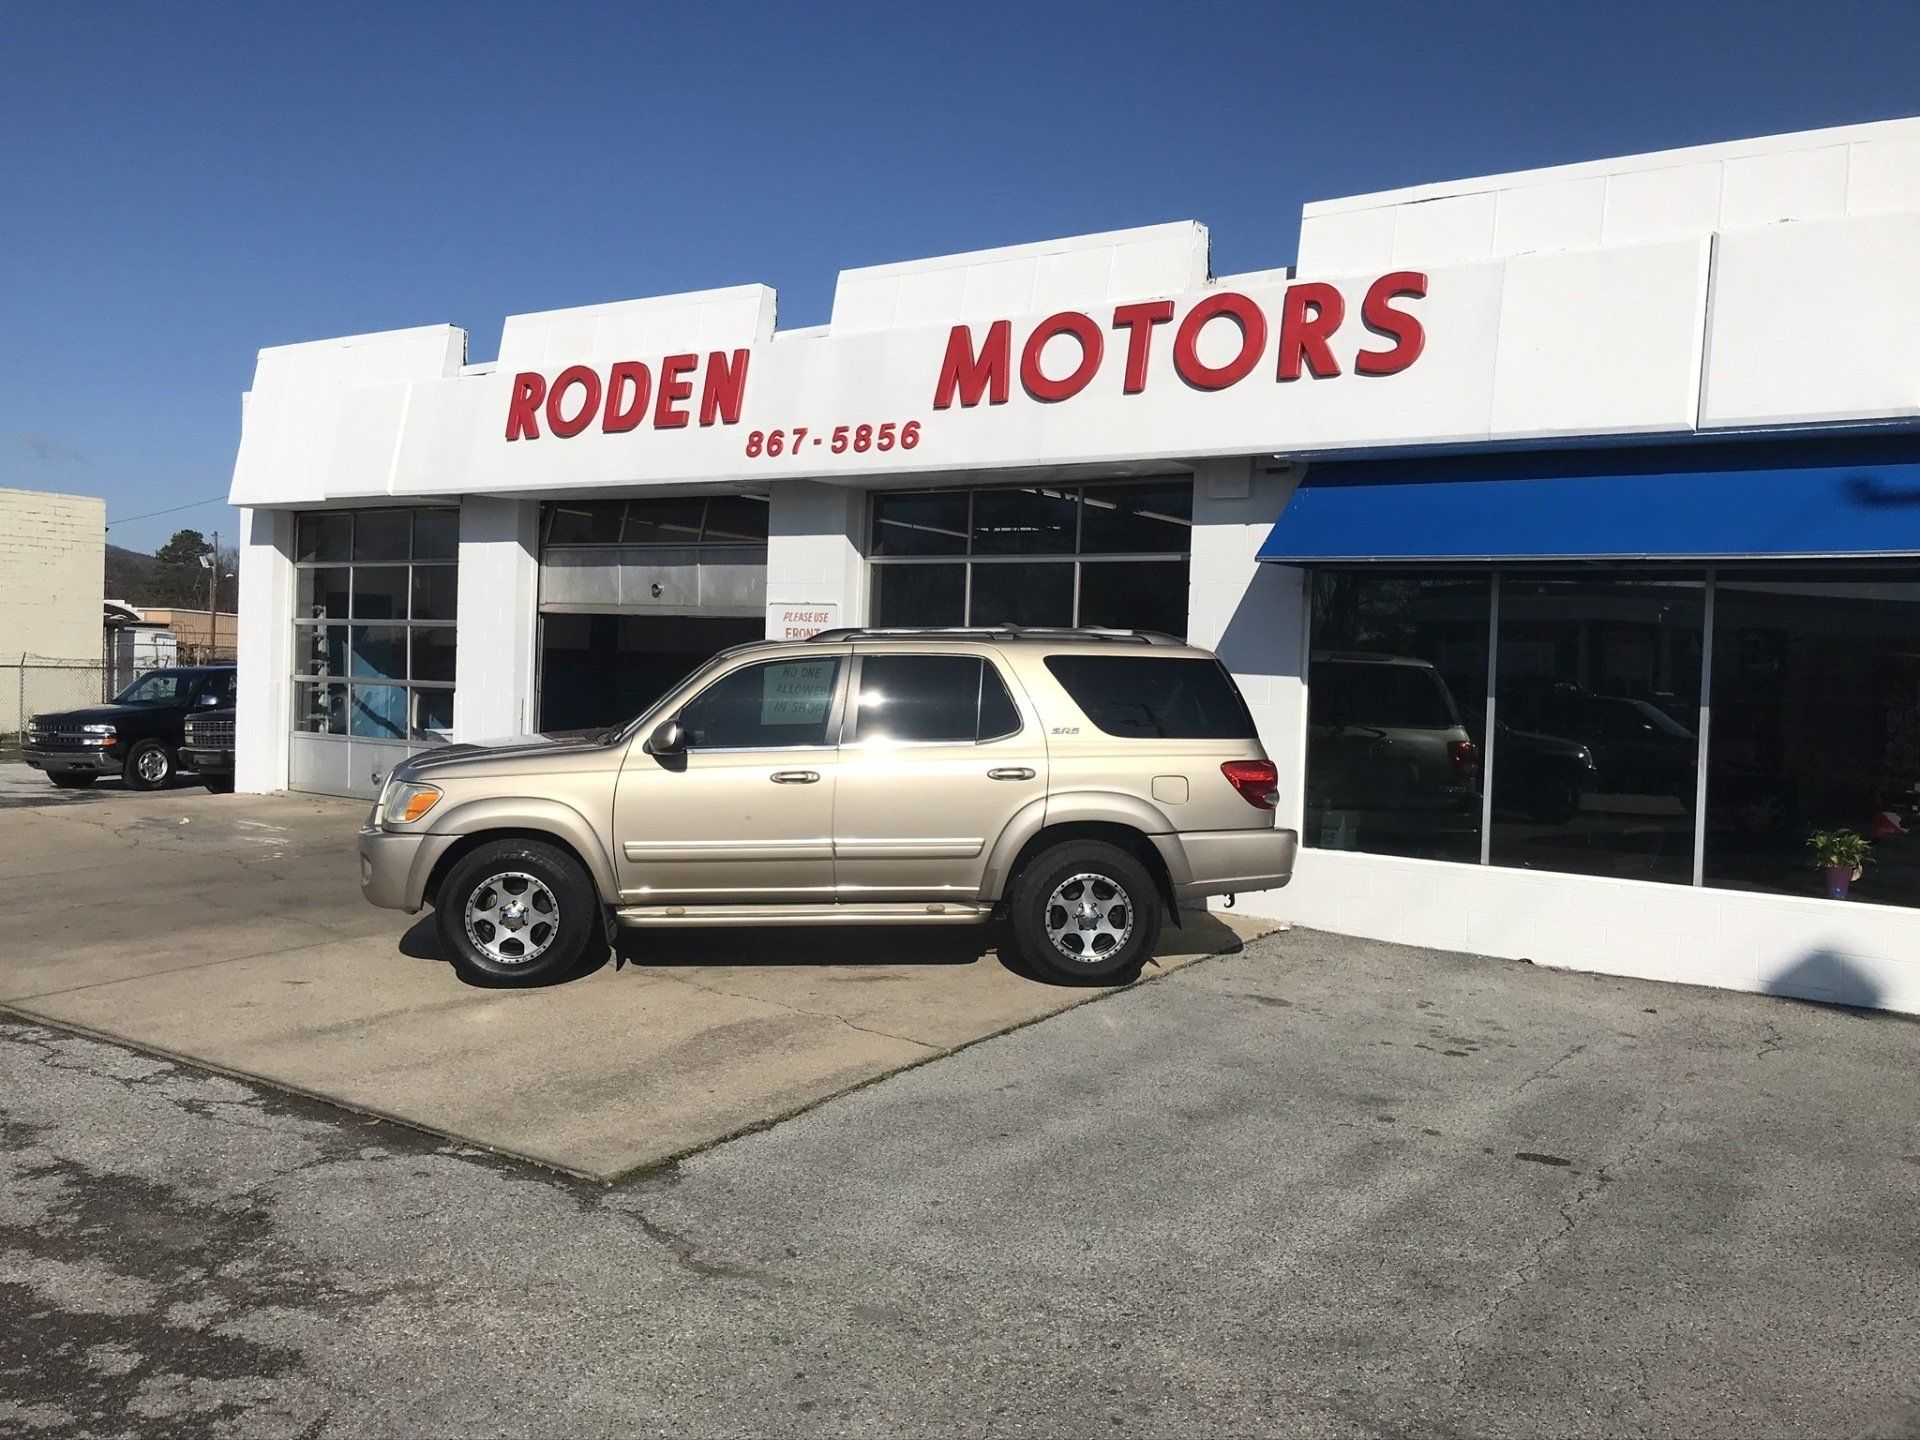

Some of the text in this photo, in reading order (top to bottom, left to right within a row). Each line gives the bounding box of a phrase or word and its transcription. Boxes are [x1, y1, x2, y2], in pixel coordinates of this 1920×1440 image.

[505, 270, 1429, 442] RODEN MOTORS
[745, 420, 922, 458] 867-5856
[783, 611, 829, 623] PLEASE USE
[782, 666, 823, 679] NO ONE
[776, 683, 827, 696] ALLOWED
[774, 701, 824, 714] IN SHOP
[1051, 727, 1080, 735] SR5
